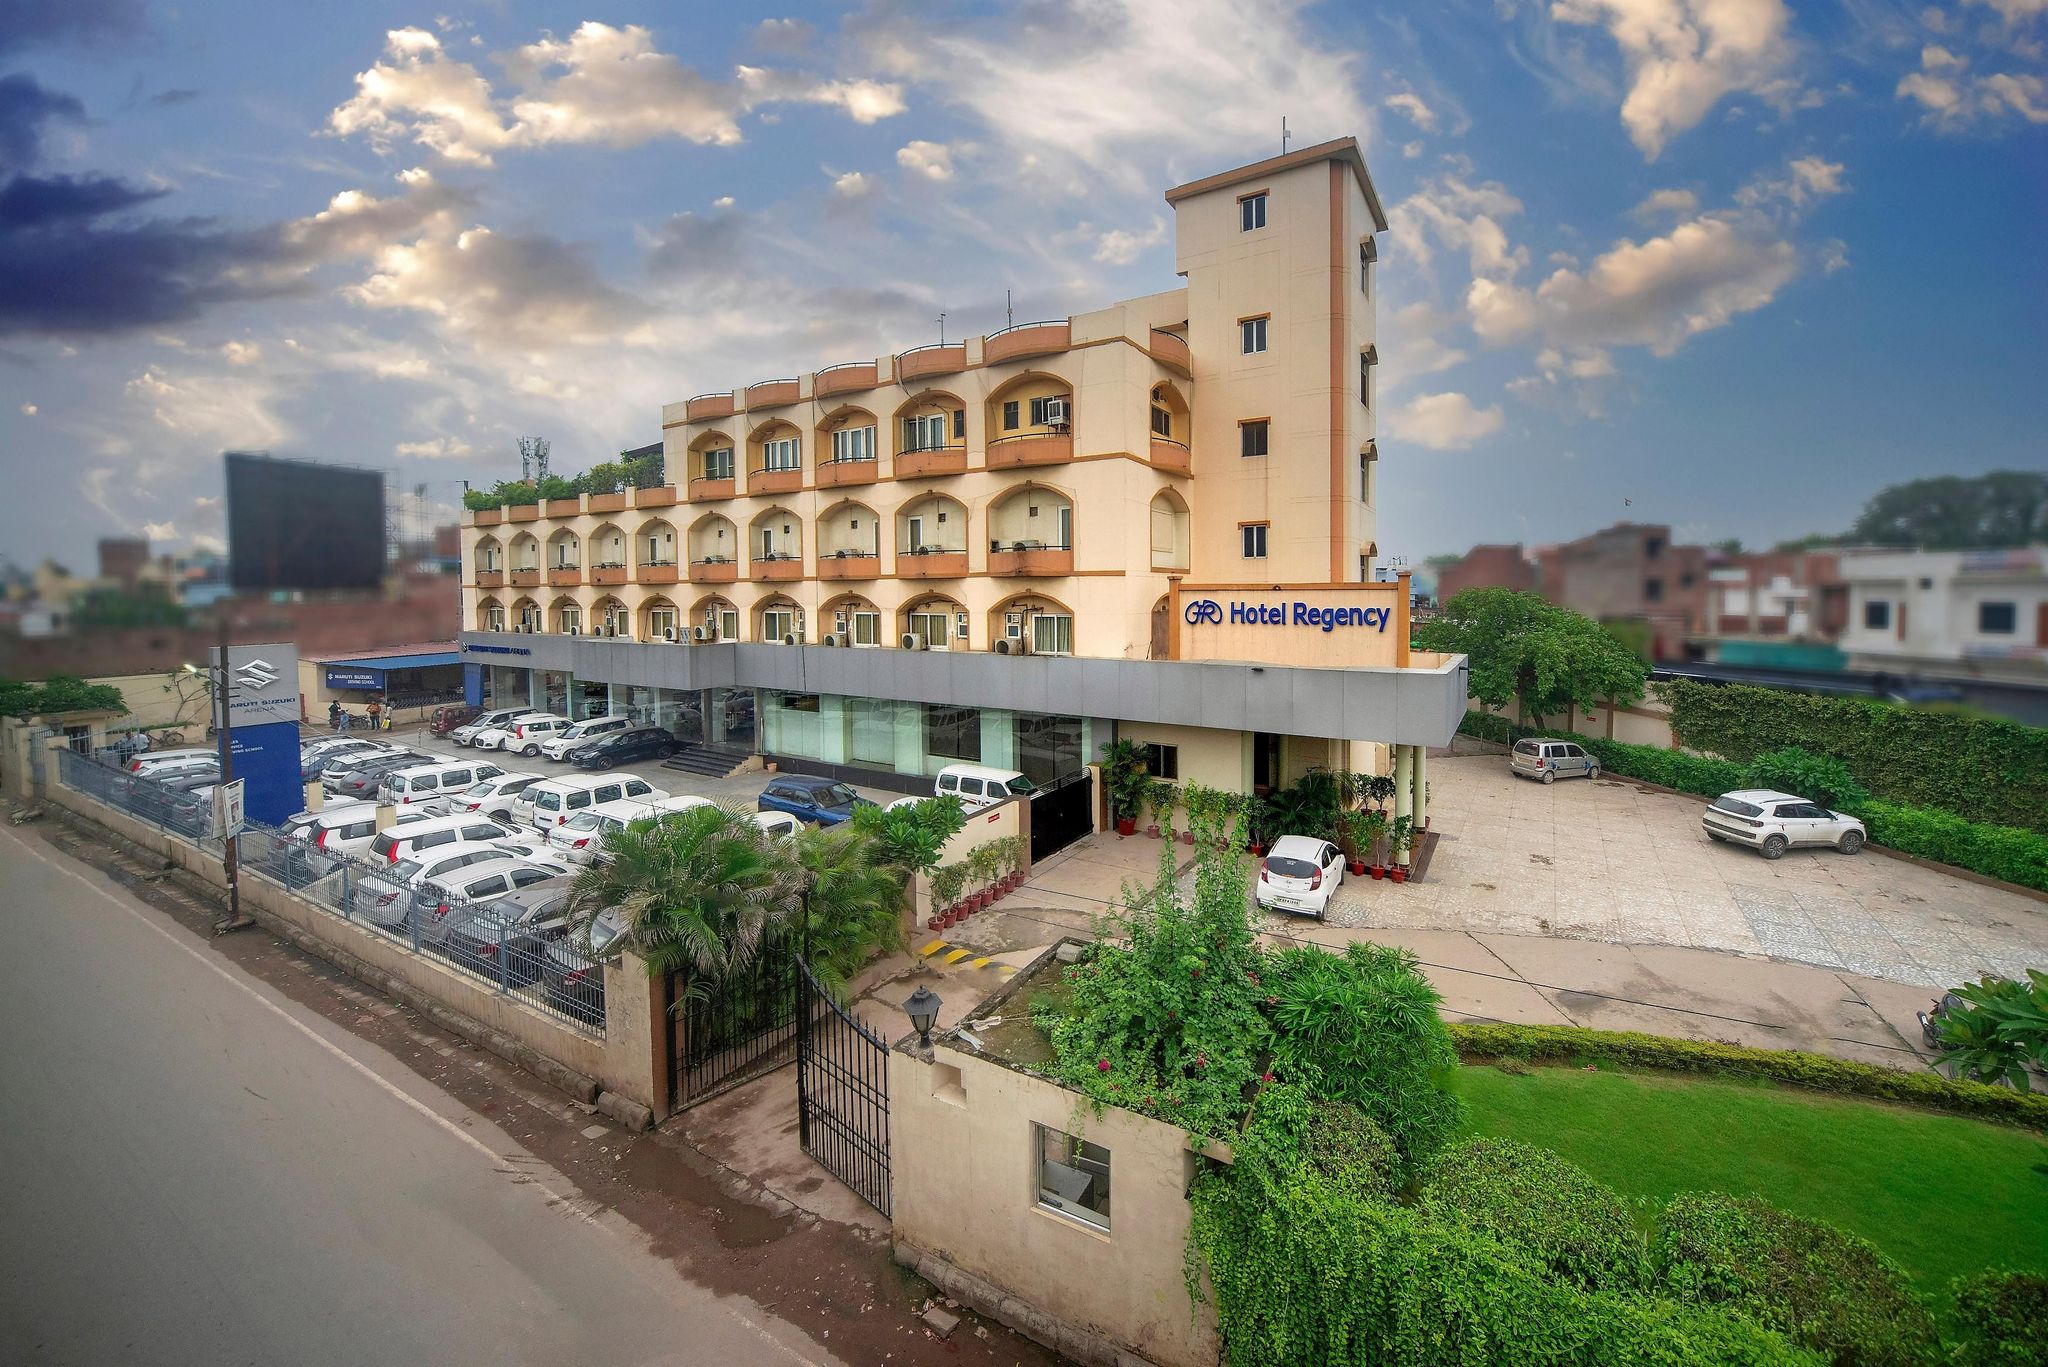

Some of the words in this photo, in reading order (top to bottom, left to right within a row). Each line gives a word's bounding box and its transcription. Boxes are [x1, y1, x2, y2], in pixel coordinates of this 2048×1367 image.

[1230, 601, 1286, 626] Hotel
[1293, 602, 1391, 632] Regency
[243, 706, 276, 714] ARENA
